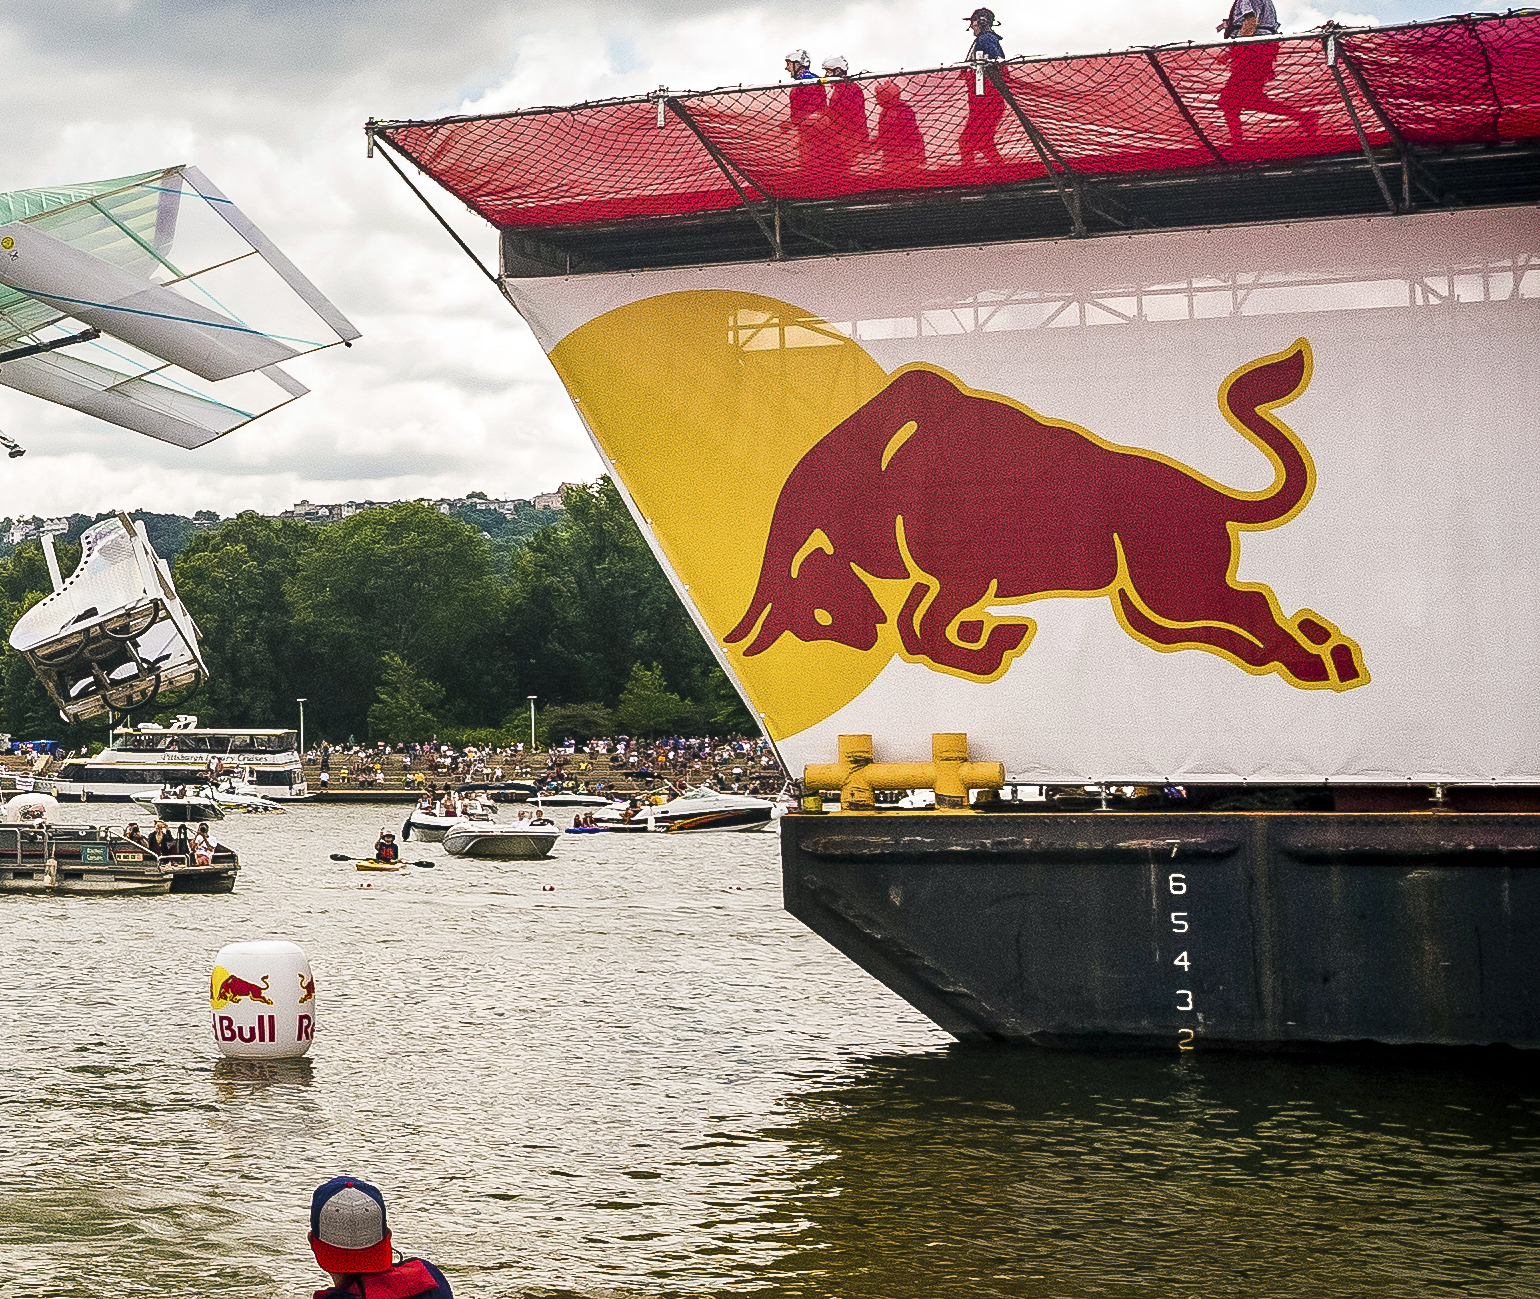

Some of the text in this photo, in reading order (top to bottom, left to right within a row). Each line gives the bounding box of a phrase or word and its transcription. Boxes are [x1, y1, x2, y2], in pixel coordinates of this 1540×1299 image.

[237, 753, 268, 762] Cruises
[1168, 873, 1187, 895] 6
[1170, 912, 1189, 933] 5
[1173, 951, 1191, 972] 4
[1176, 990, 1194, 1011] 3
[219, 1014, 276, 1043] Bull
[1178, 1028, 1195, 1050] 2
